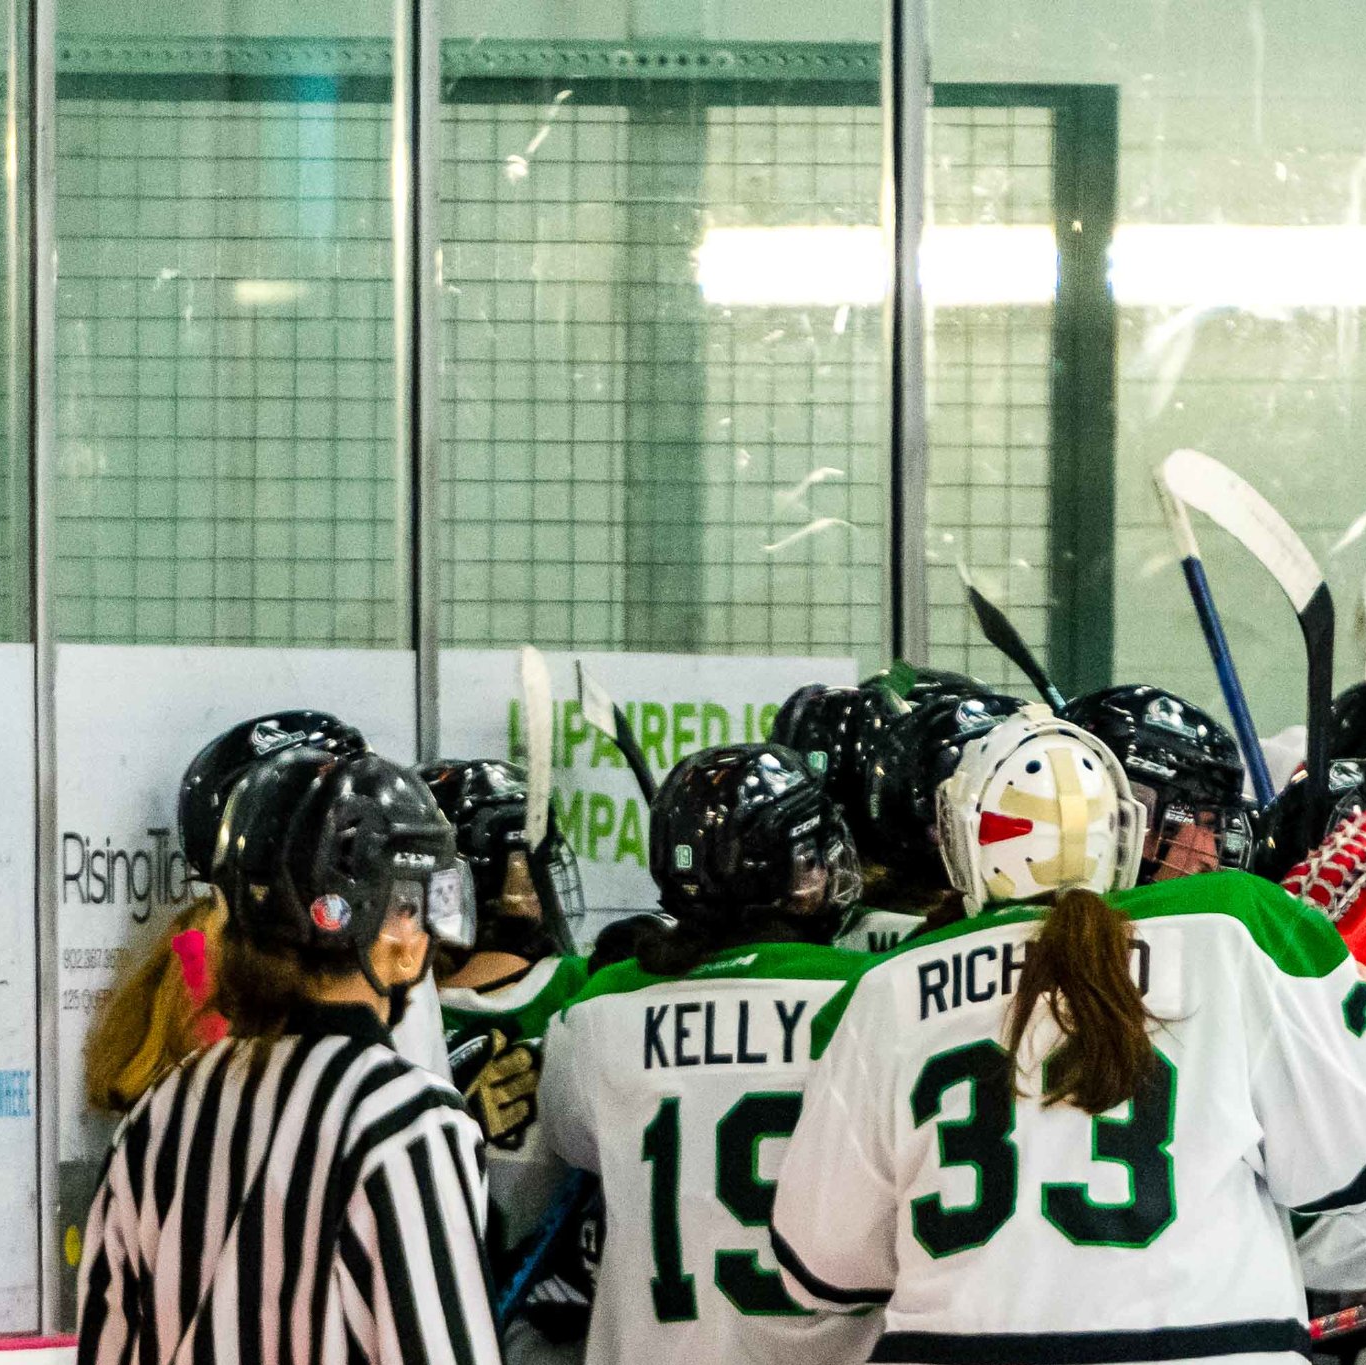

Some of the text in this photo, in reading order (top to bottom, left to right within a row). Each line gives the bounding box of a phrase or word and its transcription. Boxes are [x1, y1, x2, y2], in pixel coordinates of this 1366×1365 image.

[918, 939, 1151, 1021] RICHD
[643, 999, 809, 1070] KELLY
[910, 1037, 1178, 1260] 33
